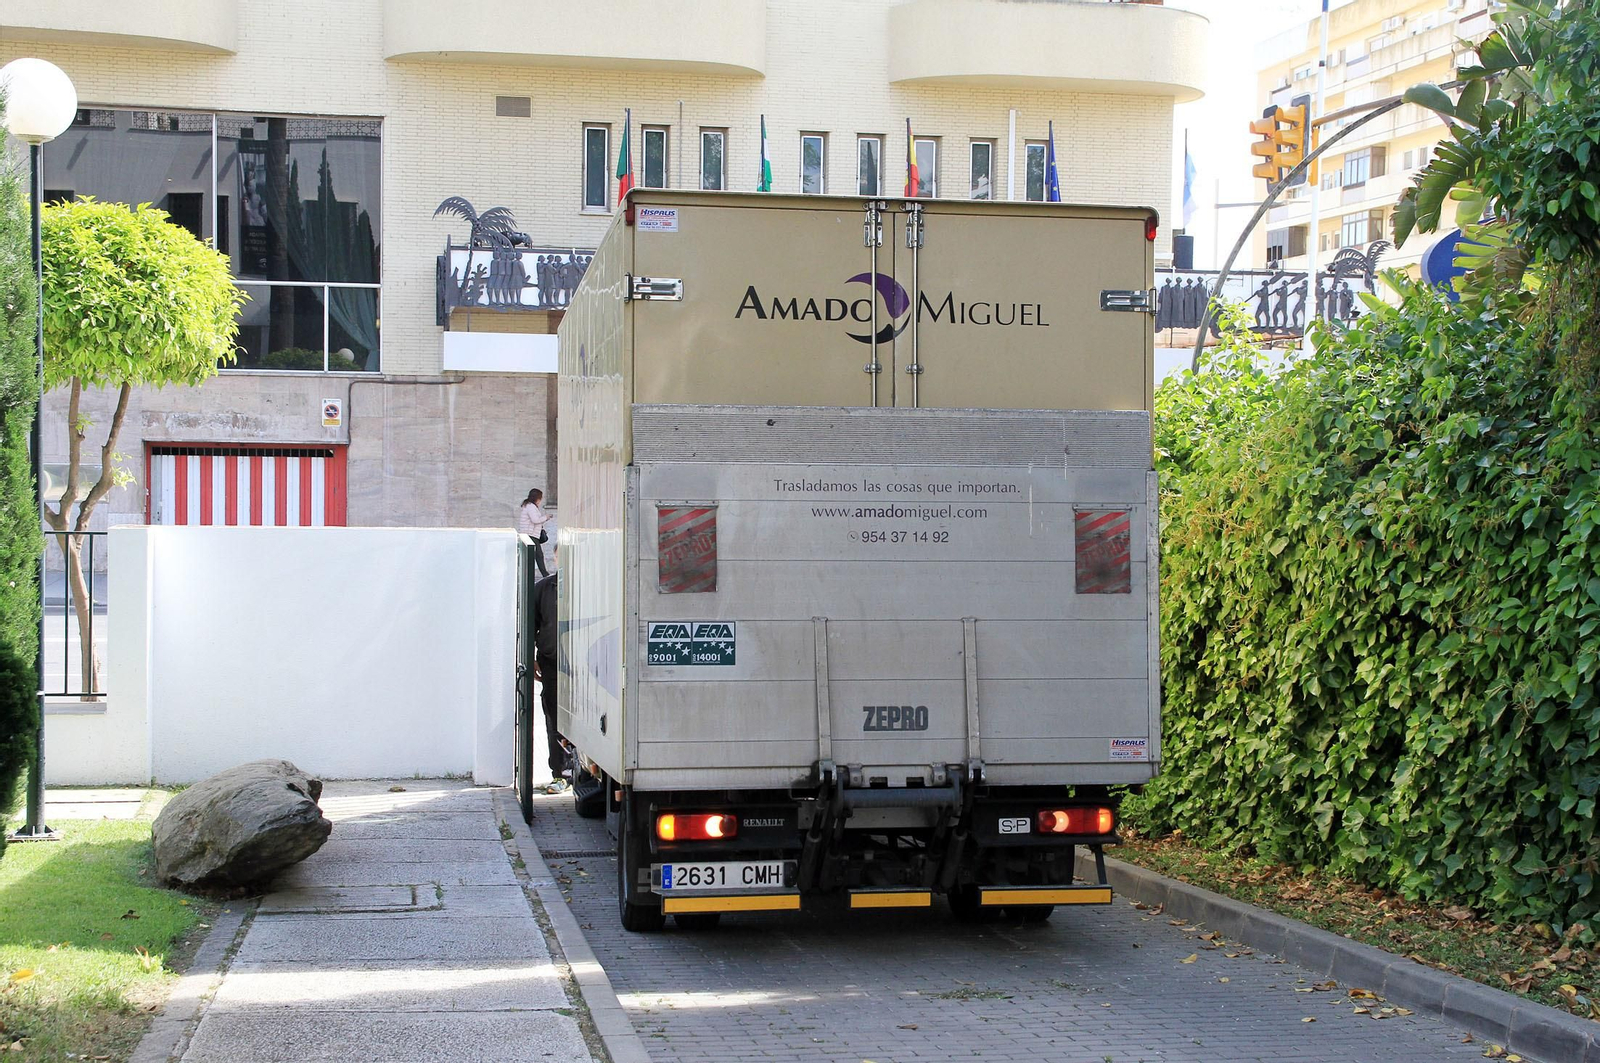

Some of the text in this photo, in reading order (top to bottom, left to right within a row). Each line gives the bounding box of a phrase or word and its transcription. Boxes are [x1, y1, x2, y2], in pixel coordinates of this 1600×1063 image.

[734, 285, 1050, 327] AMADO MIGUEL
[773, 479, 1021, 496] Trasladamos las cosas que importan.
[811, 504, 987, 521] www.amadomiguel.com
[861, 531, 949, 543] 954 37 14 92
[697, 653, 720, 661] 14001
[863, 706, 928, 731] ZEPRO
[743, 819, 785, 827] RENAULT
[676, 866, 725, 886] 2631
[742, 865, 780, 885] CMH
